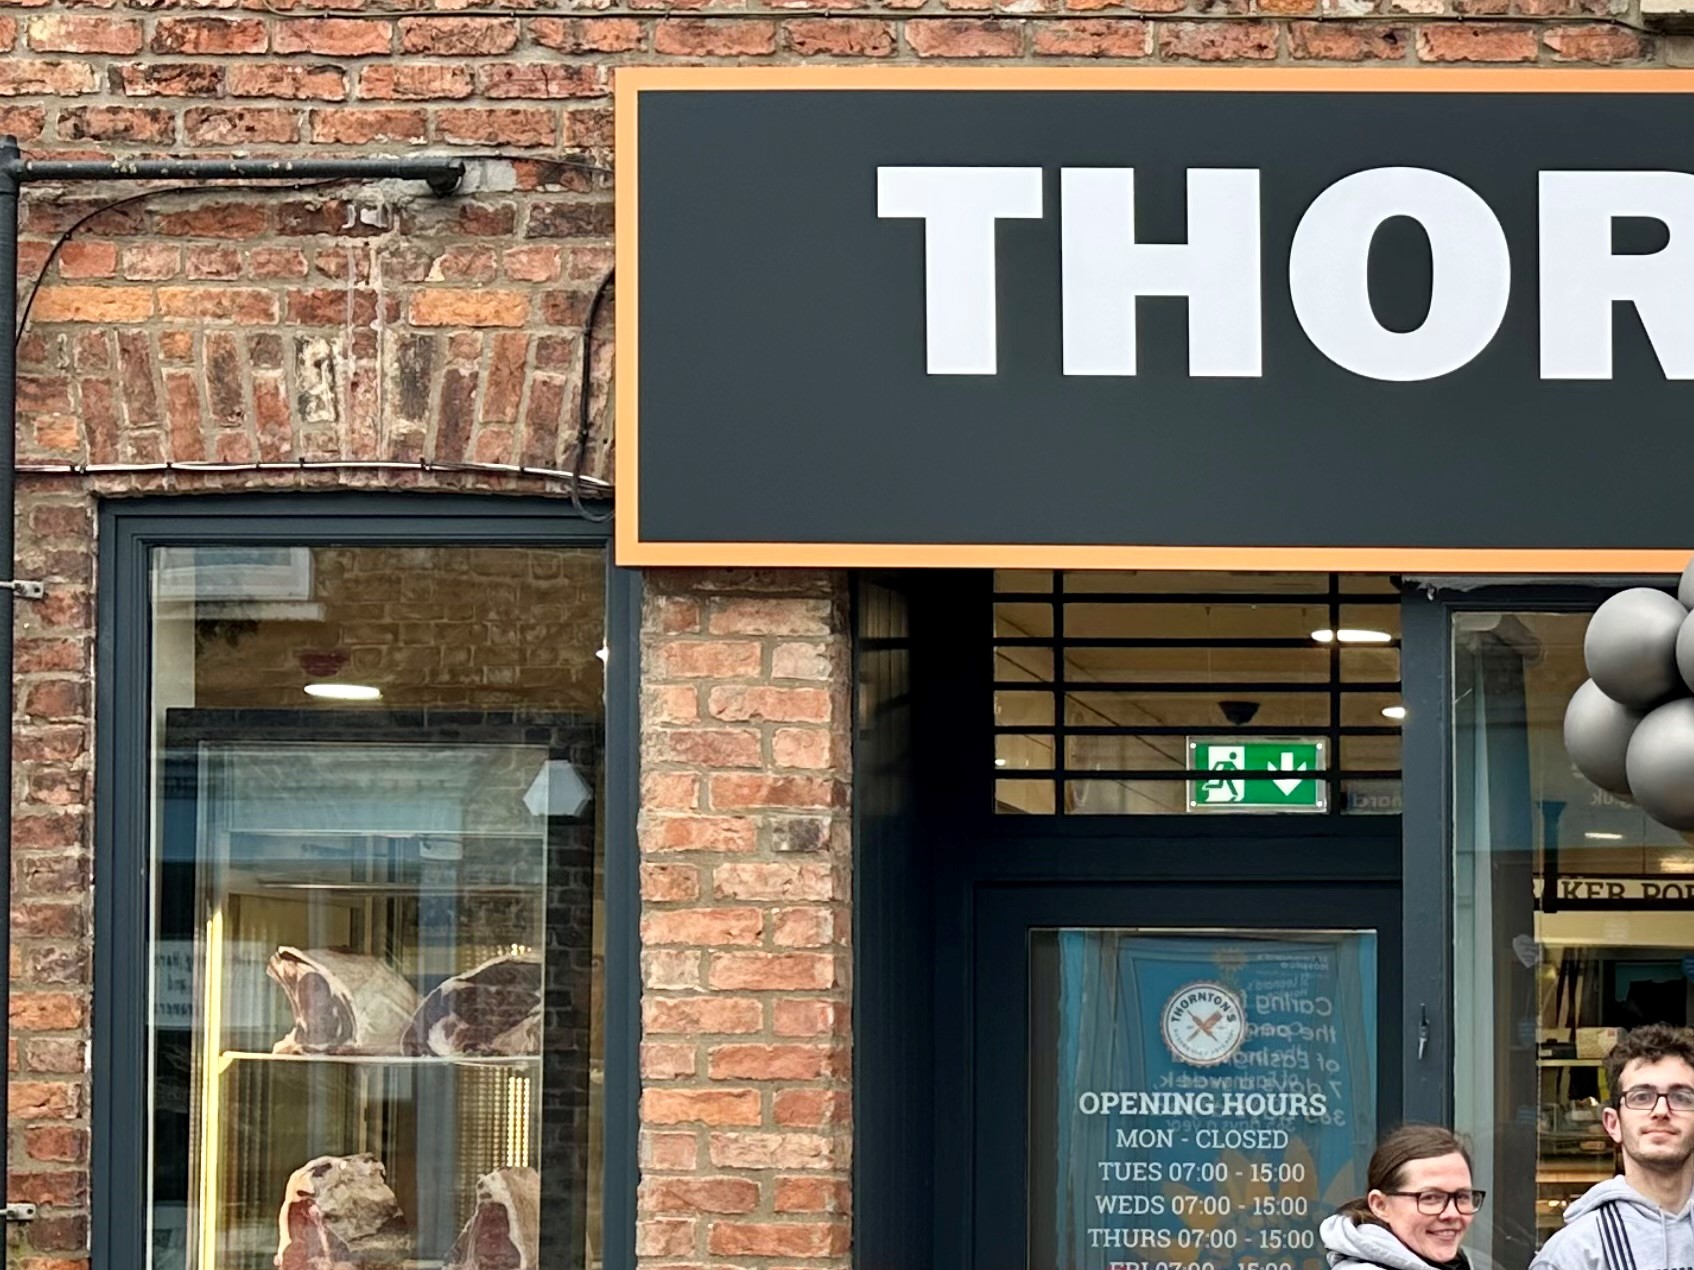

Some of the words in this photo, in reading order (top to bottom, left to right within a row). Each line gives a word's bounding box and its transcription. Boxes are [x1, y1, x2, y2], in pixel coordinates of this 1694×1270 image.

[1079, 1092, 1215, 1116] OPENING
[1221, 1092, 1327, 1117] HOURS
[1115, 1128, 1175, 1148] MON
[1195, 1129, 1289, 1149] CLOSED
[1098, 1162, 1163, 1182] TUES
[1168, 1162, 1228, 1182] 07:00
[1249, 1162, 1305, 1183] 15:00
[1095, 1195, 1165, 1215] WEDS
[1170, 1196, 1231, 1215] 07:00
[1252, 1196, 1308, 1216] 15:00
[1087, 1228, 1171, 1248] THURS
[1177, 1229, 1237, 1249] 07:00
[1259, 1229, 1315, 1249] 15:00
